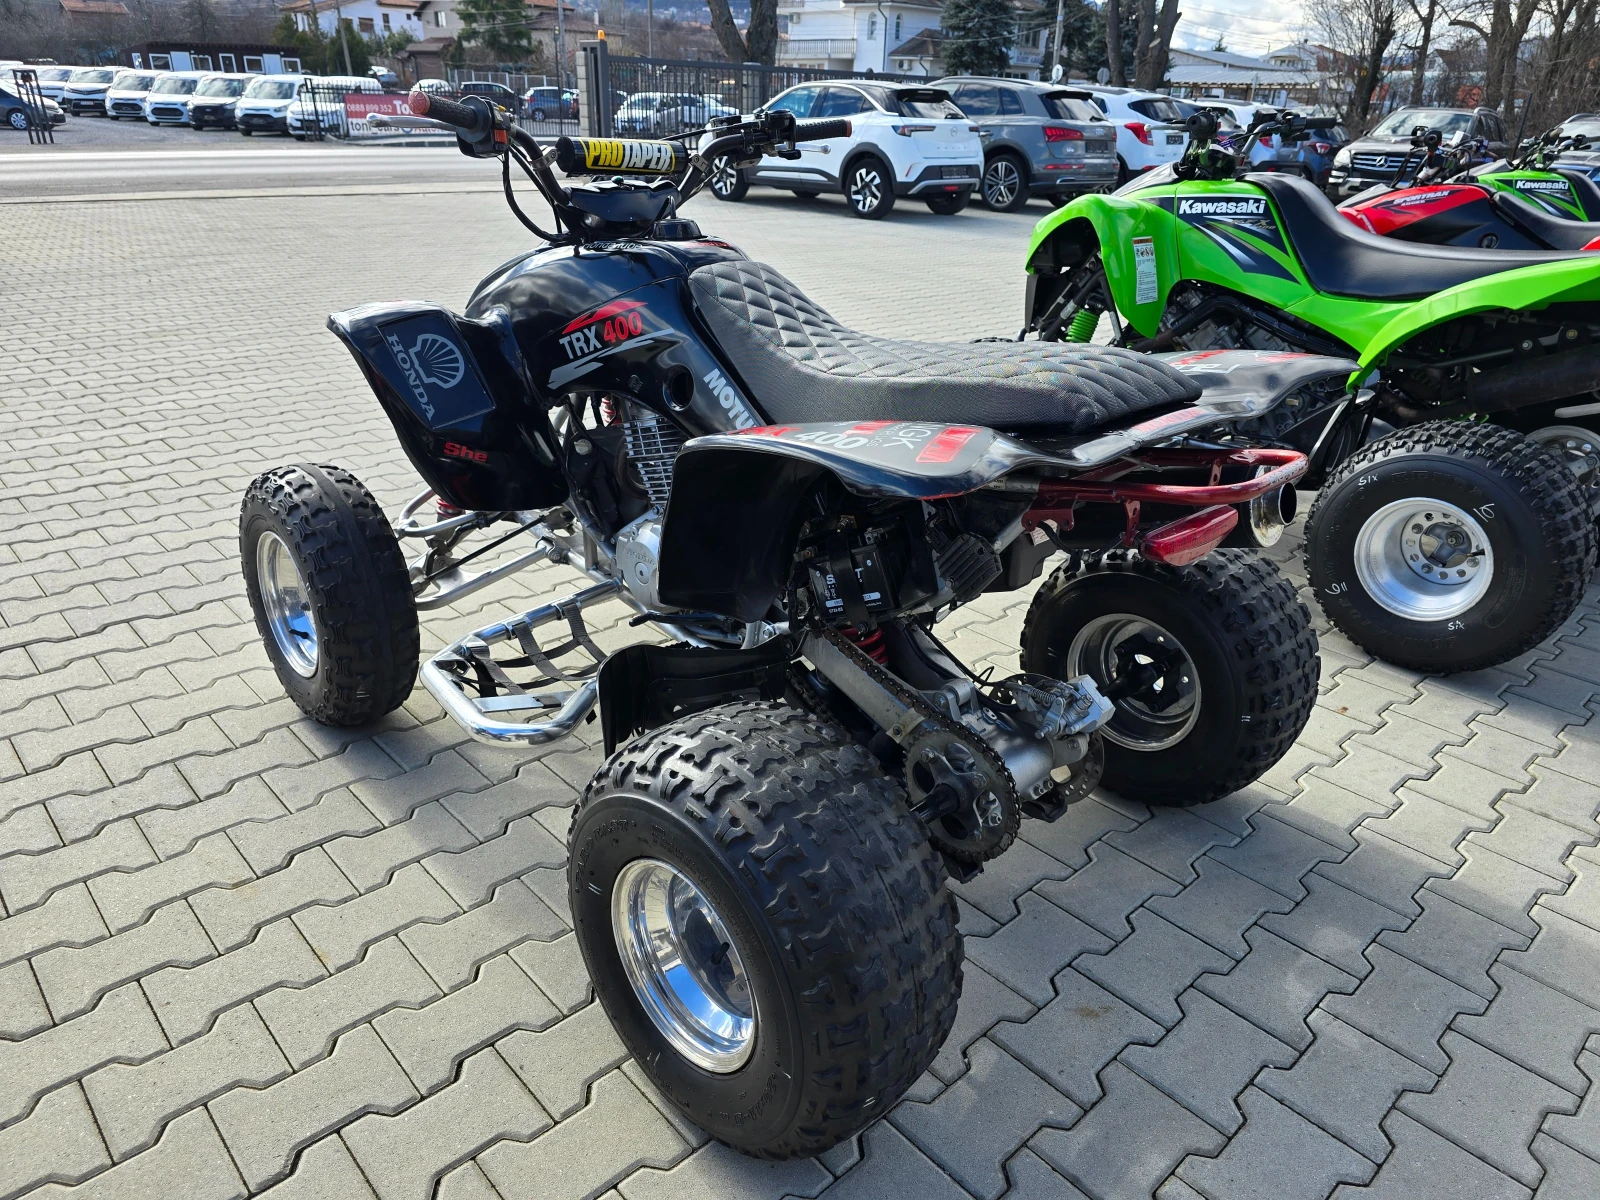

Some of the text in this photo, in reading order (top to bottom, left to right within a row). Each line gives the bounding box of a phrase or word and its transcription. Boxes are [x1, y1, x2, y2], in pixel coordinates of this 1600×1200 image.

[393, 100, 414, 115] To
[1516, 180, 1569, 190] Kawasaki
[1179, 199, 1266, 215] Kawasaki
[558, 311, 643, 360] TRX 400
[386, 333, 436, 421] HONDA
[702, 367, 758, 431] MOTU
[793, 431, 869, 449] 400
